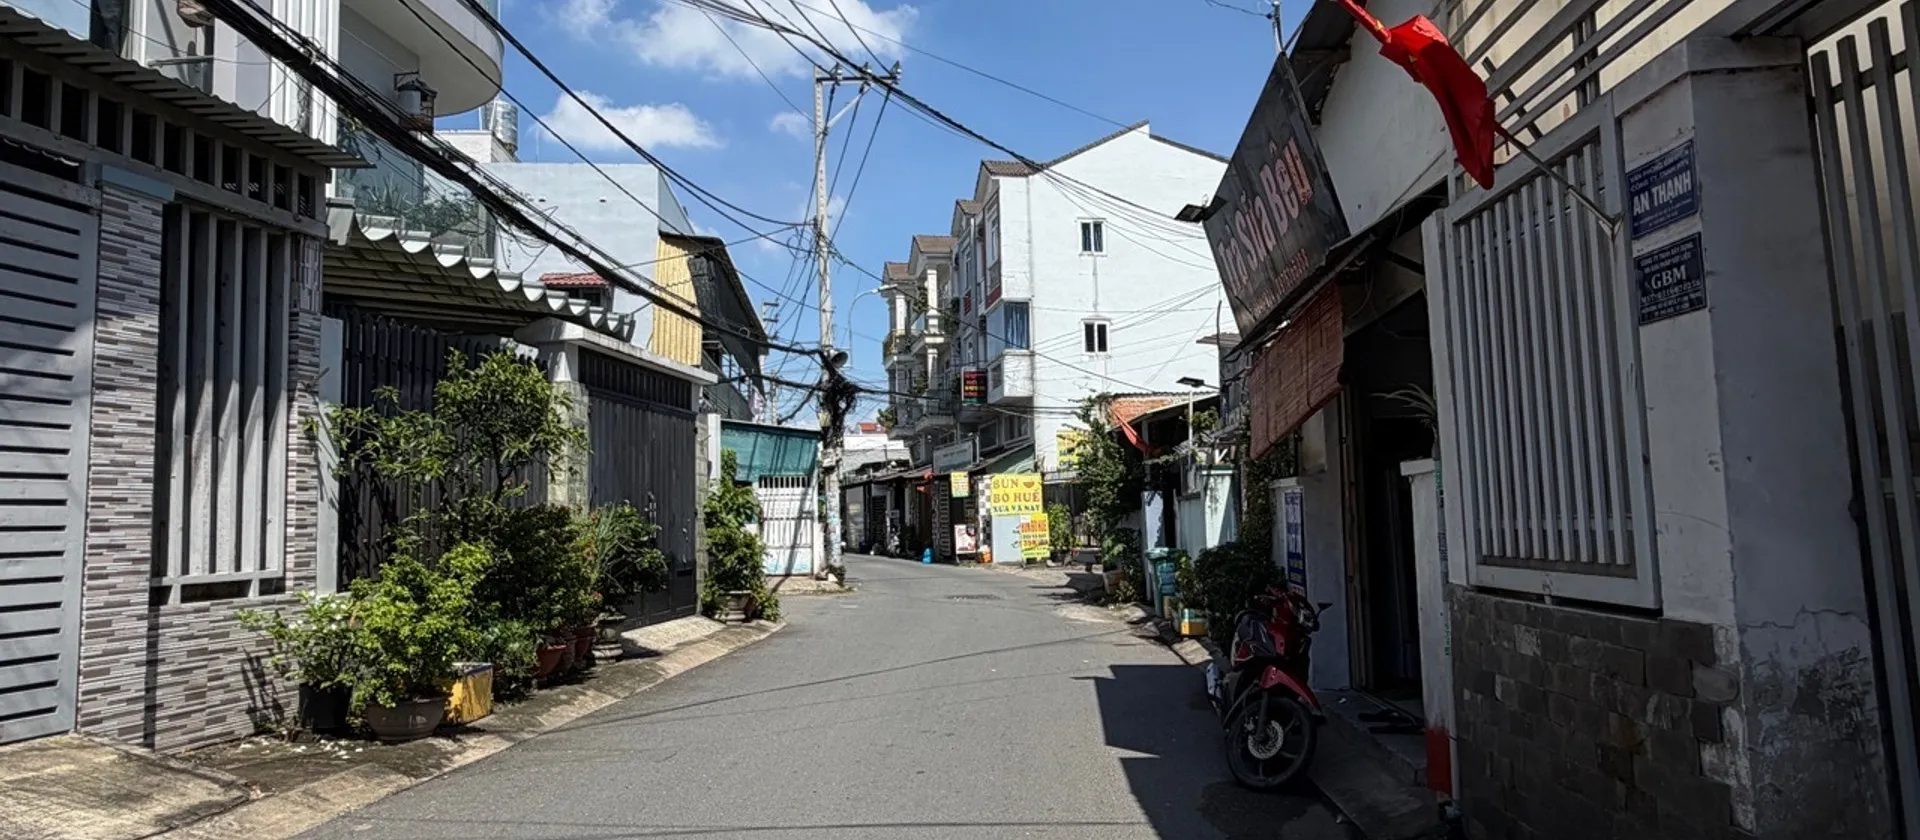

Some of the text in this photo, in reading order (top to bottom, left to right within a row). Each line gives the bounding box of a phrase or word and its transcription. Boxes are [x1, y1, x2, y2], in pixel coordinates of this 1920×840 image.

[1633, 191, 1650, 216] AN
[1651, 169, 1692, 207] THẠNH
[1651, 264, 1687, 289] GBM
